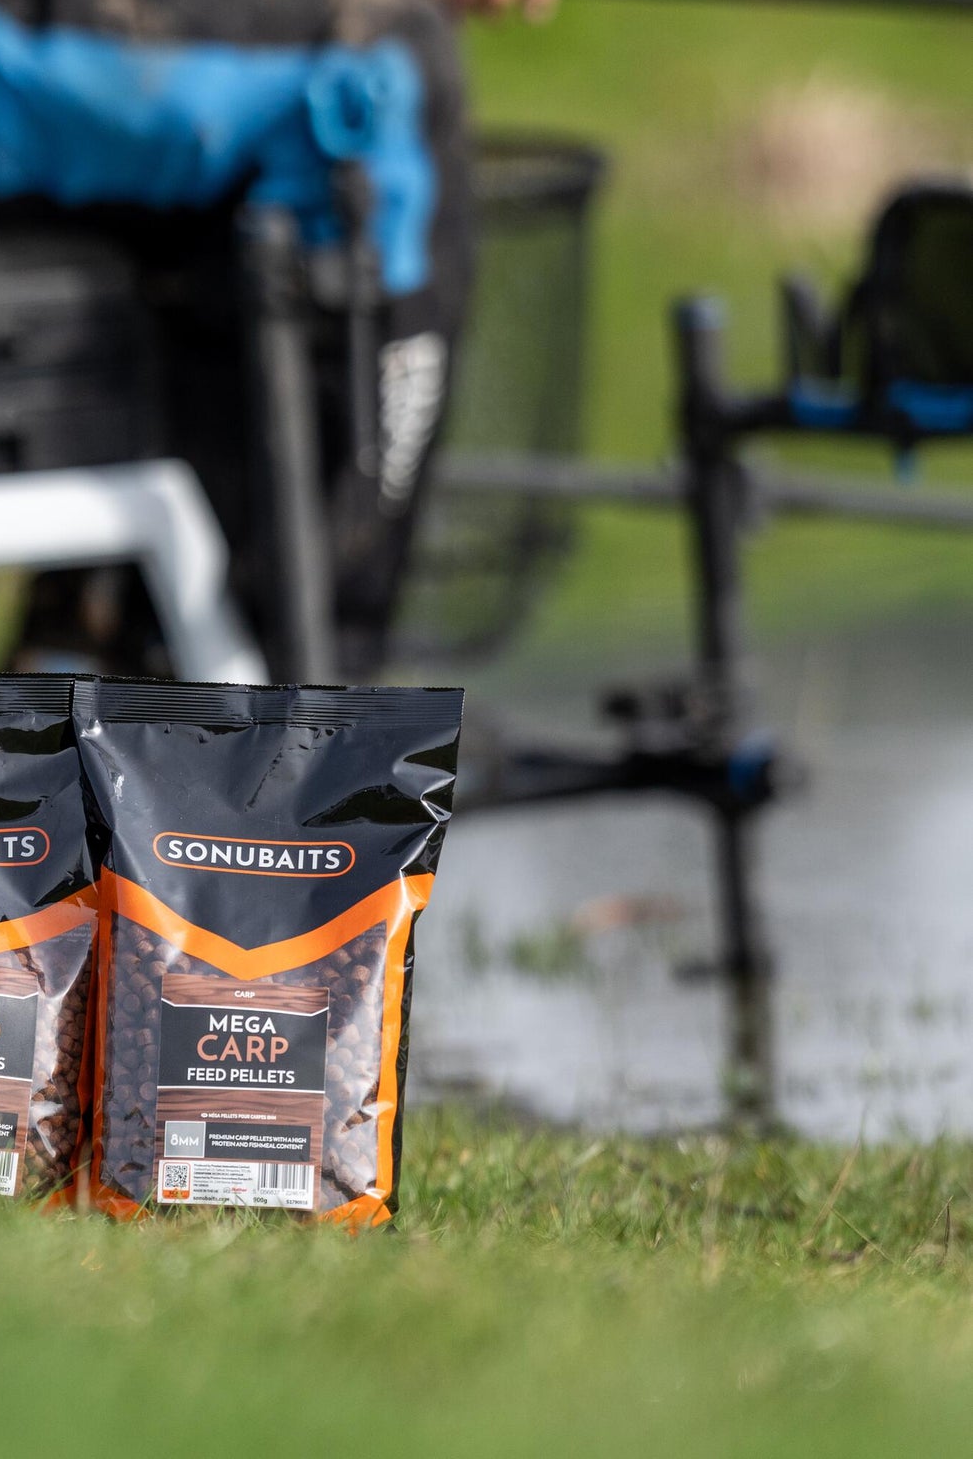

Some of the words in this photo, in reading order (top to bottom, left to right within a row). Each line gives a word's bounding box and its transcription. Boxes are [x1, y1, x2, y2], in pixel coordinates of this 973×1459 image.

[167, 839, 341, 870] SONUBAITS
[234, 990, 255, 998] CARP
[209, 1014, 277, 1034] MEGA
[197, 1034, 289, 1063] CARP
[187, 1067, 226, 1081] FEED
[230, 1069, 295, 1084] PELLETS
[170, 1133, 199, 1147] 8MM
